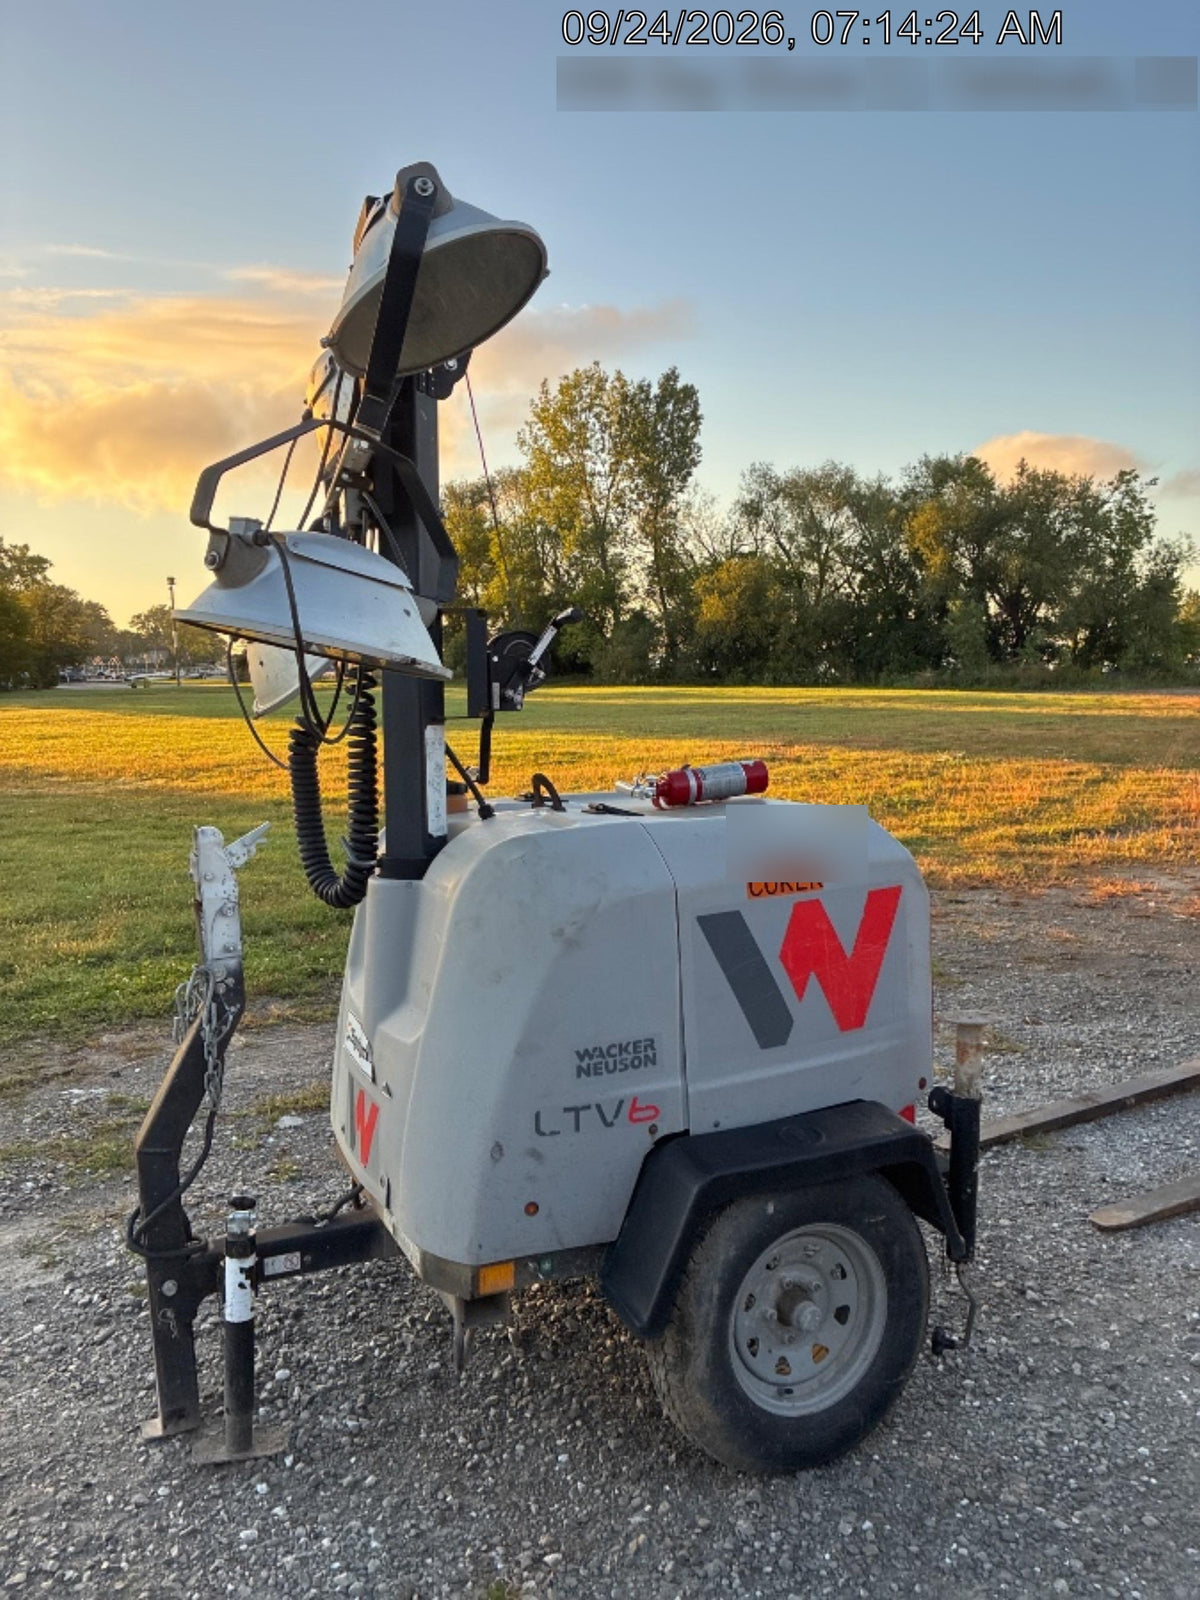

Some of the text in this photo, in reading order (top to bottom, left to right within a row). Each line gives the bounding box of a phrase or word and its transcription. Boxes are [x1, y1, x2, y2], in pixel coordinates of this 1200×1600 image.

[574, 1038, 656, 1063] WACKER
[575, 1052, 657, 1079] NEUSON
[534, 1096, 661, 1137] LTV6
